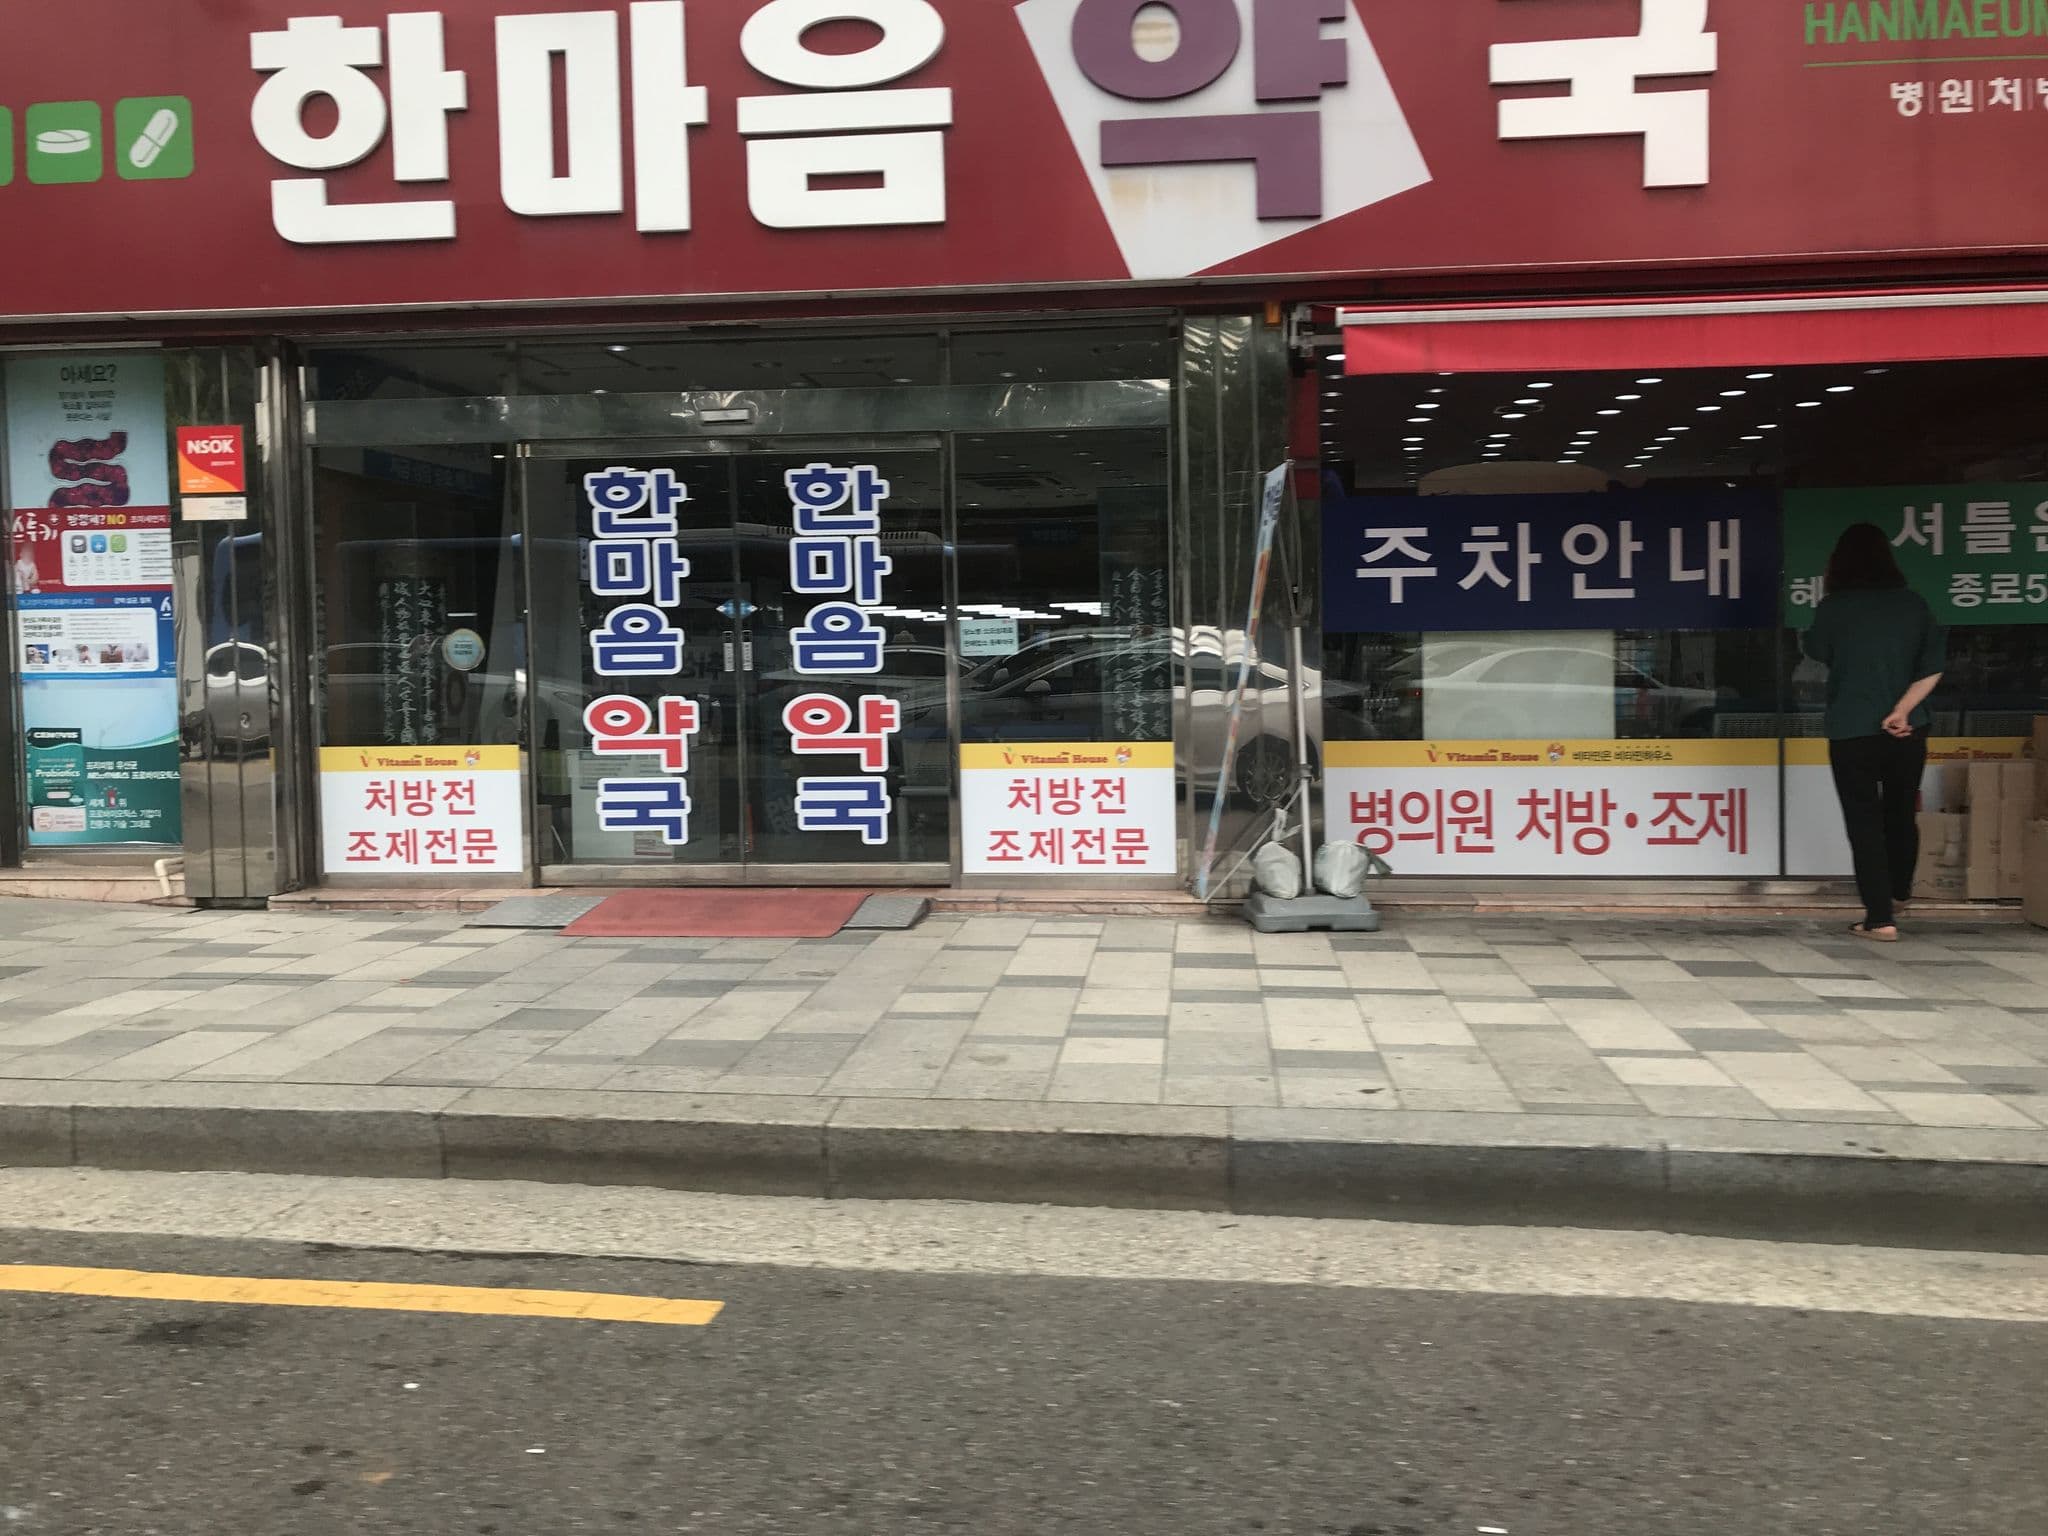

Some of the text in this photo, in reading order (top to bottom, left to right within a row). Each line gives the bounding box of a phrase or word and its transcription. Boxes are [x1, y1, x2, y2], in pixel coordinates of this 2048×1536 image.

[250, 0, 953, 243] 한마음
[60, 363, 117, 384] 아세요?
[186, 438, 235, 455] NSOK
[1355, 518, 1741, 604] 주차안내
[1789, 575, 1826, 608] 혜
[35, 768, 81, 778] Probiotics
[377, 757, 459, 767] Vitamin House
[1021, 754, 1109, 764] Vitamin House
[1445, 752, 1498, 762] Vitamin
[1500, 752, 1539, 762] House
[364, 778, 476, 817] 처방전
[1007, 777, 1127, 816] 처방전
[1349, 788, 1496, 856] 병의원
[345, 828, 498, 865] 조제전문
[986, 827, 1150, 866] 조제전문
